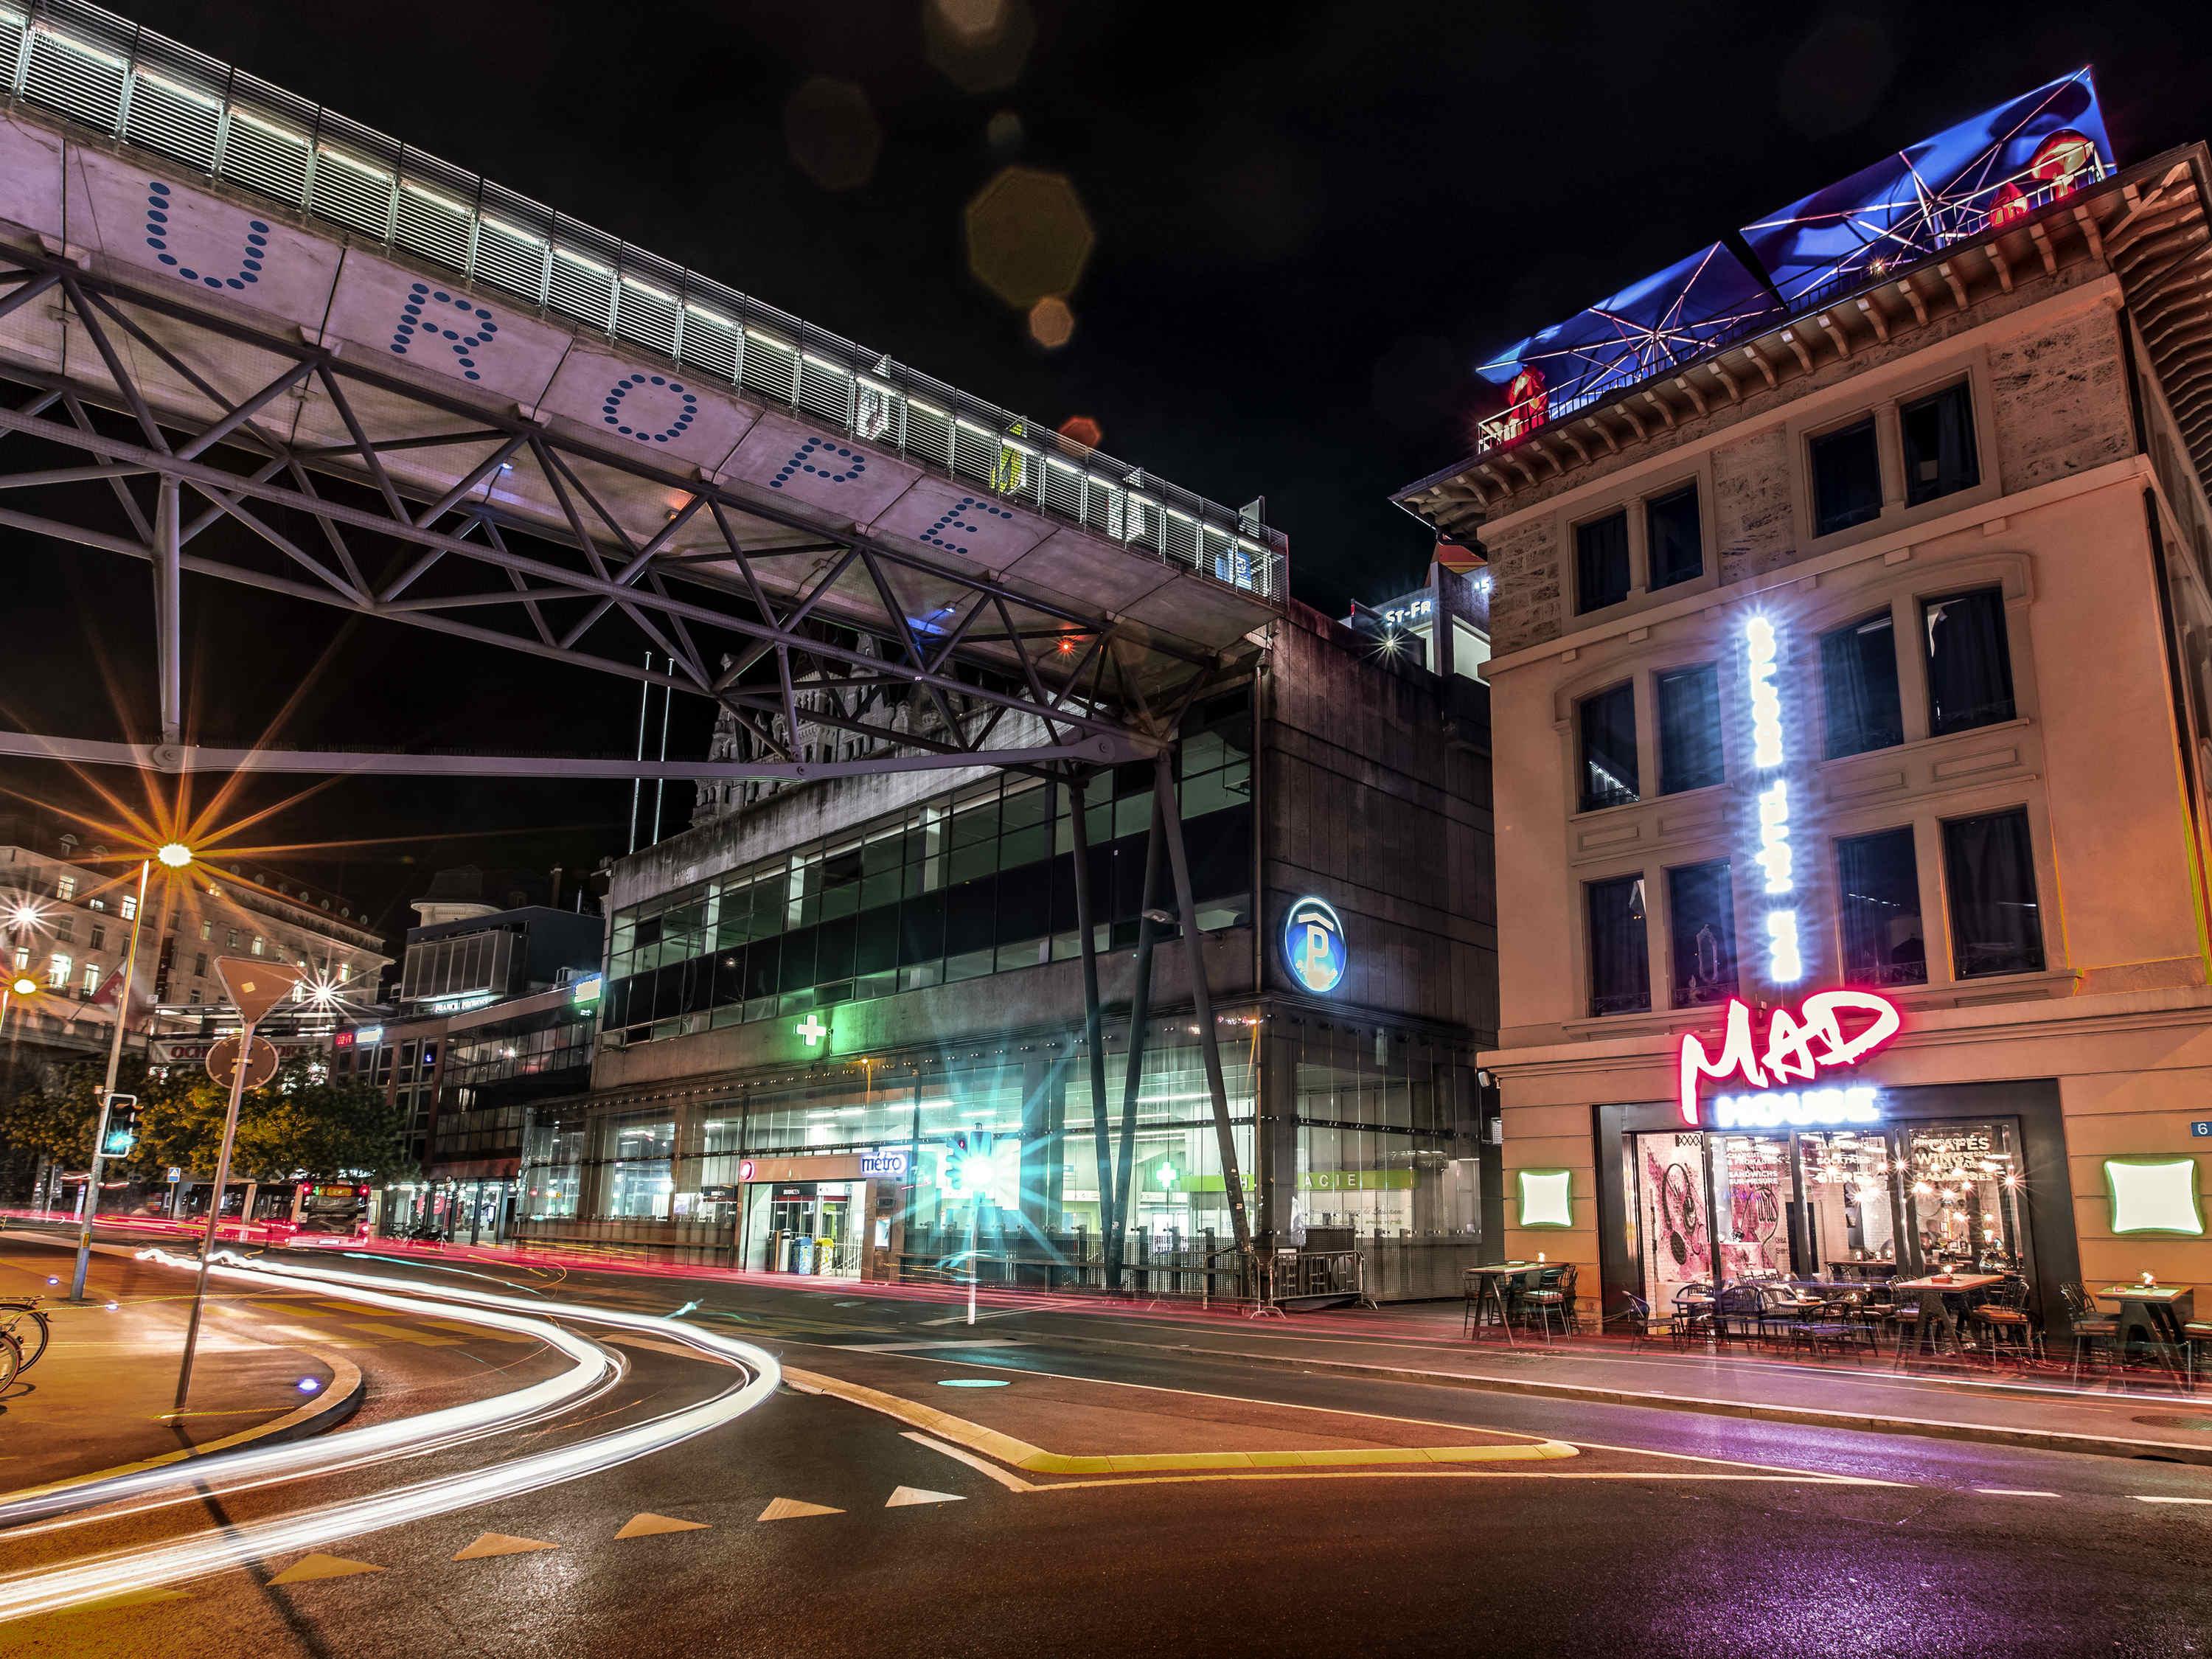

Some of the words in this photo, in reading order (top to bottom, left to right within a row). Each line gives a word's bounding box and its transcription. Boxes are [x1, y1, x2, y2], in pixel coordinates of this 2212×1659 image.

[1681, 990, 1900, 1124] MAD
[2198, 1123, 2208, 1135] 6
[861, 1152, 903, 1173] métro
